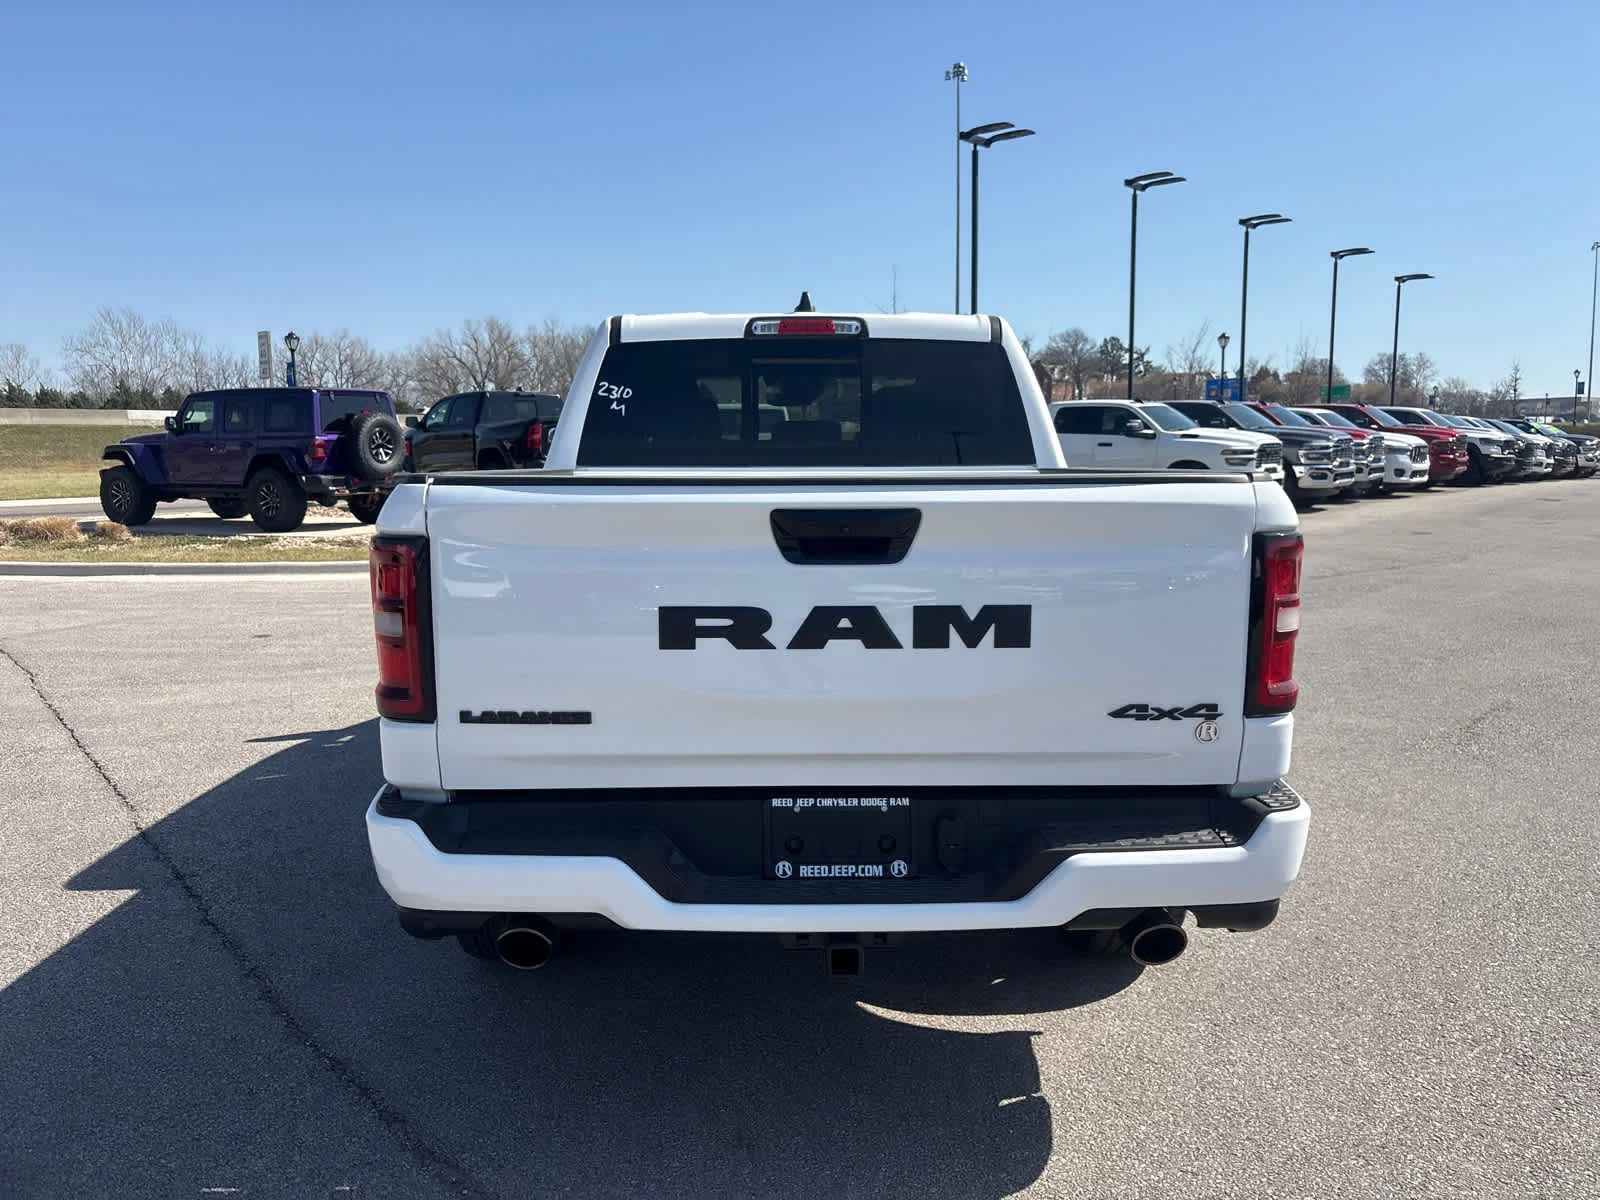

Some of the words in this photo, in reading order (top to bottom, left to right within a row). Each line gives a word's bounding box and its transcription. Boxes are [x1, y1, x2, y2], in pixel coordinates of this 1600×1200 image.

[598, 381, 632, 399] 2310
[658, 605, 1032, 650] RAM
[772, 798, 792, 807] REED
[795, 798, 815, 807] JEEP
[816, 798, 858, 807] CHRYSLER
[860, 798, 888, 807] DODGE
[889, 798, 910, 807] RAM
[800, 865, 883, 877] REEDJEEP.COM
